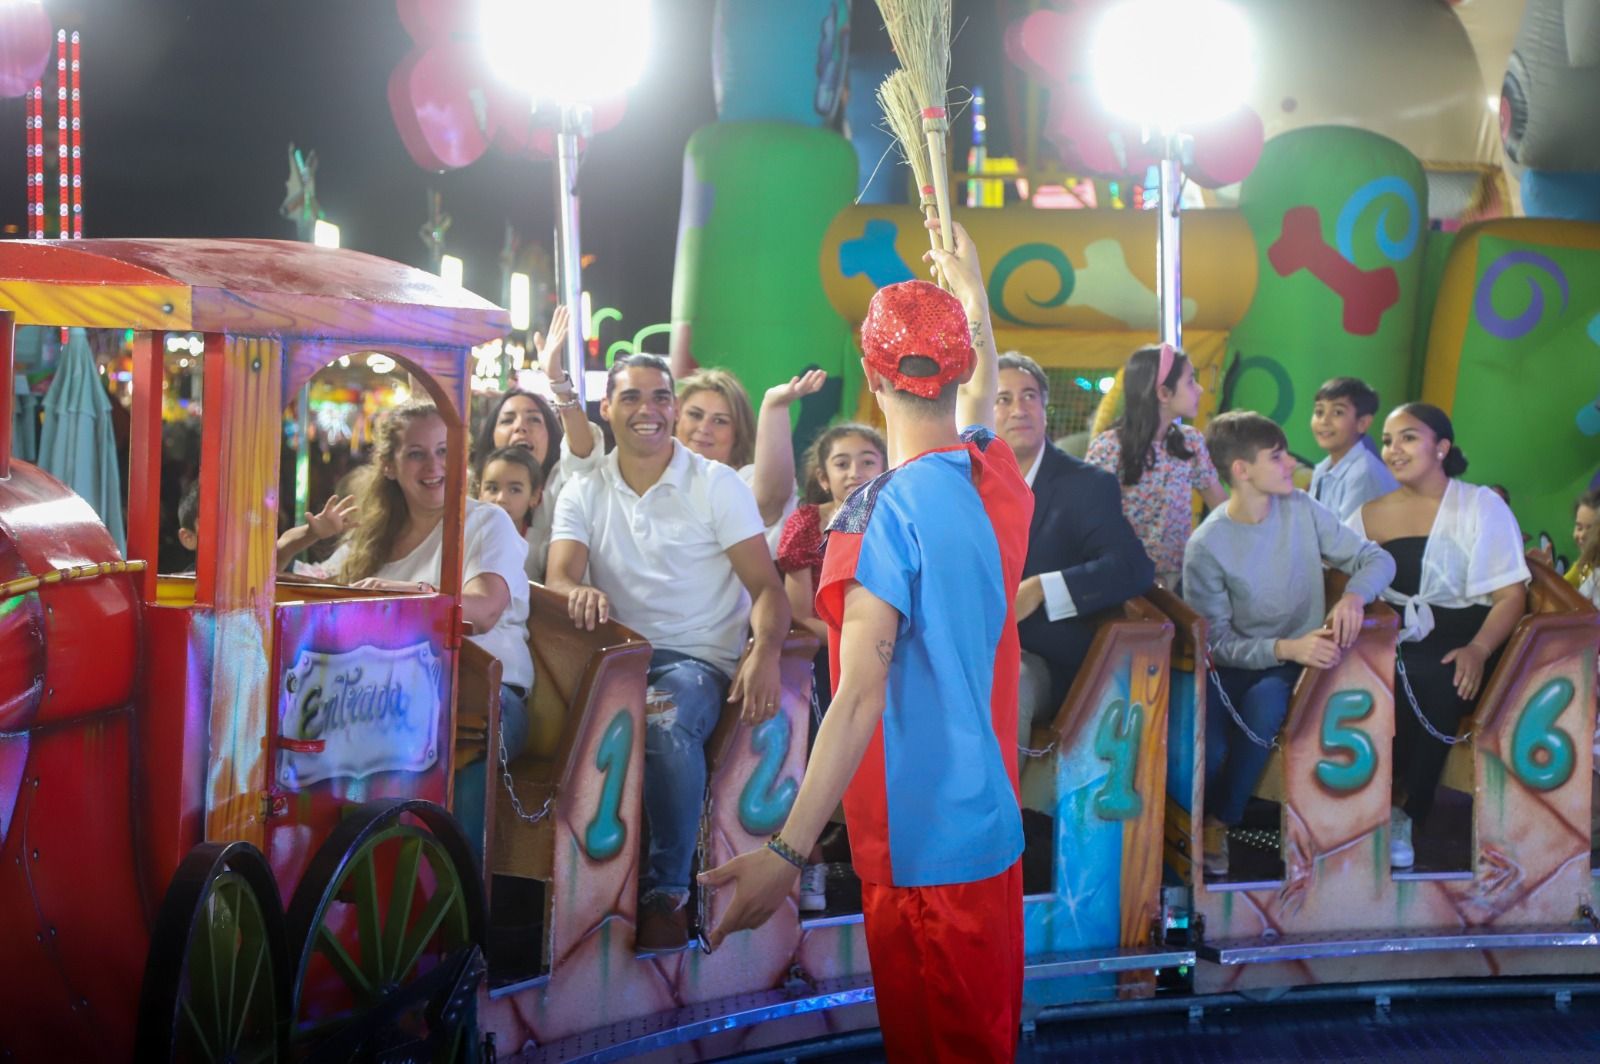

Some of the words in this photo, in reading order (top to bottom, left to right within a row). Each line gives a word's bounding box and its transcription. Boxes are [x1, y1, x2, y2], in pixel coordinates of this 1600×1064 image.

[300, 666, 411, 738] Entrada
[1094, 699, 1143, 820] 4
[1316, 690, 1376, 790] 5
[1511, 677, 1576, 791] 6
[585, 709, 633, 859] 1
[739, 708, 798, 833] 2
